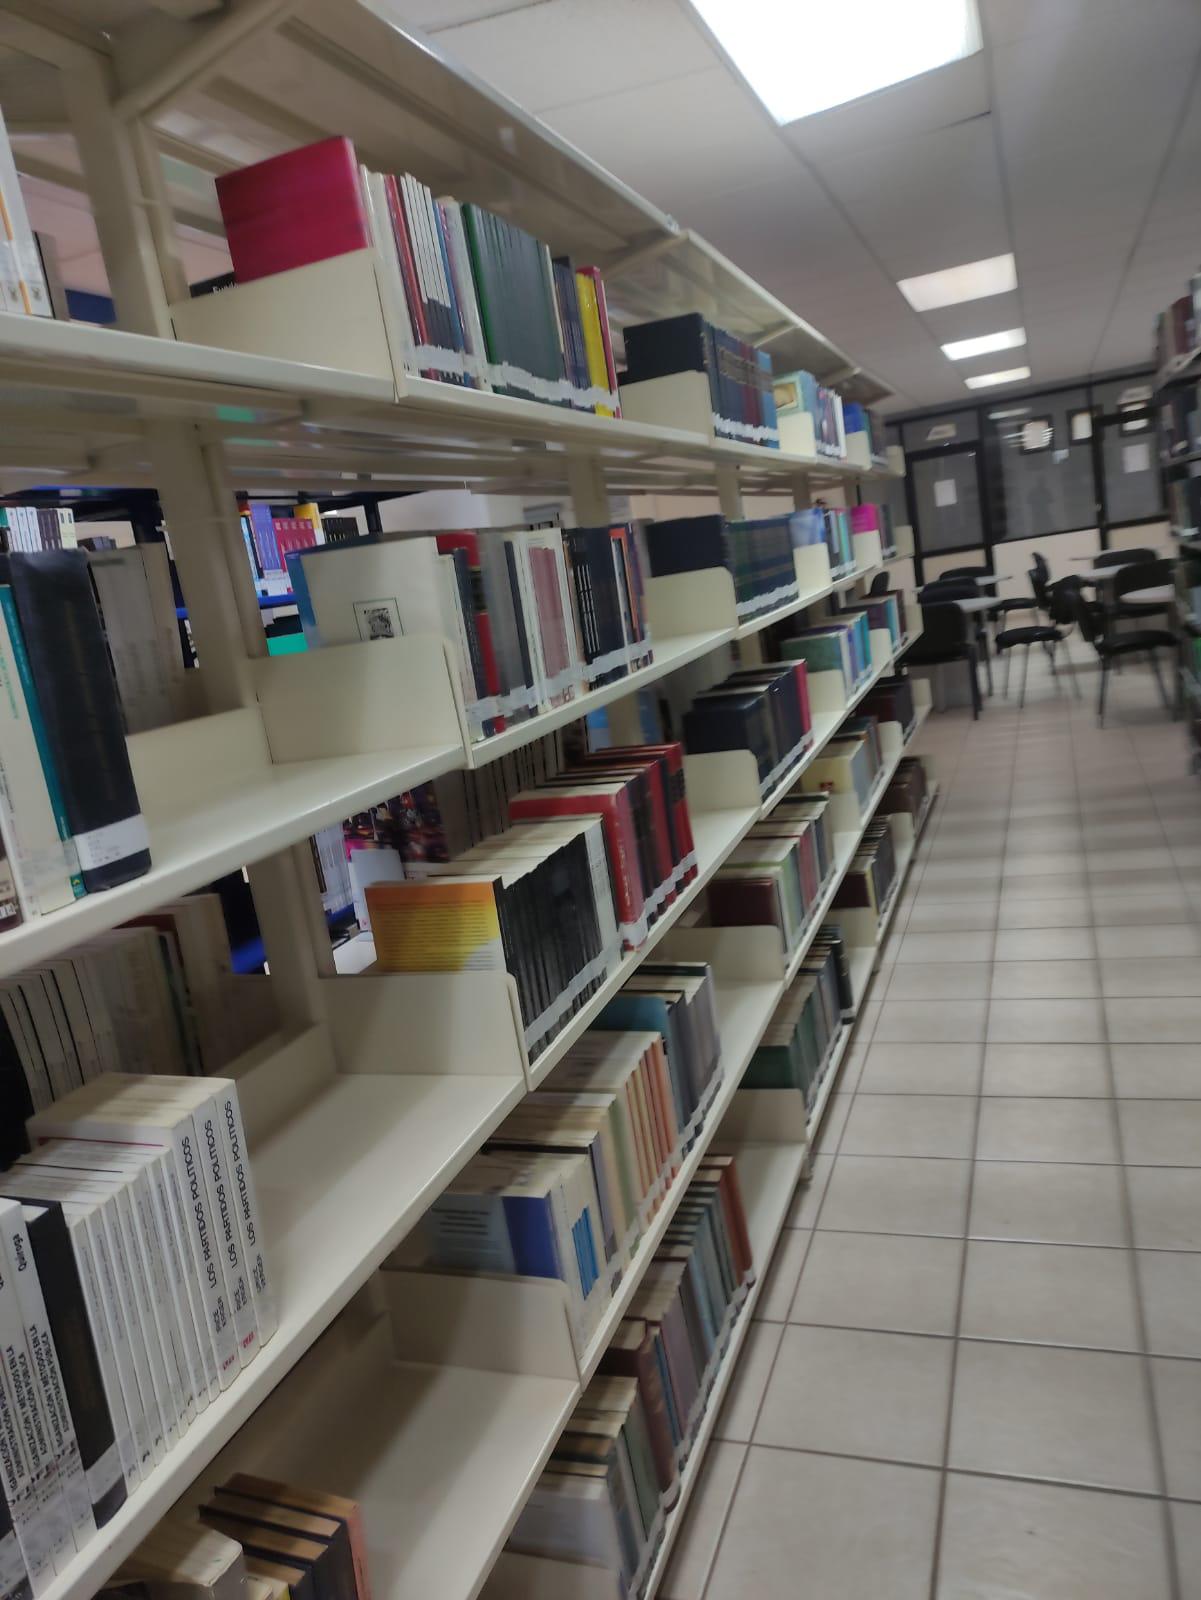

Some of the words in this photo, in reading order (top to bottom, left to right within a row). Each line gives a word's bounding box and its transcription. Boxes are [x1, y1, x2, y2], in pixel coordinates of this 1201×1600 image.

[224, 1100, 241, 1161] POLITICOS
[204, 1119, 222, 1181] POLITICOS
[181, 1136, 200, 1200] POLITICOS
[236, 1163, 252, 1220] PARTIDOS
[217, 1184, 233, 1241] PARTIDOS
[195, 1202, 212, 1260] PARTIDOS
[247, 1221, 257, 1246] LOS
[13, 1234, 27, 1271] Quiroga
[228, 1243, 238, 1267] LOS
[207, 1262, 218, 1288] LOS
[29, 1324, 37, 1336] LA
[32, 1336, 40, 1347] EN
[6, 1345, 14, 1357] LA
[9, 1357, 17, 1369] EN
